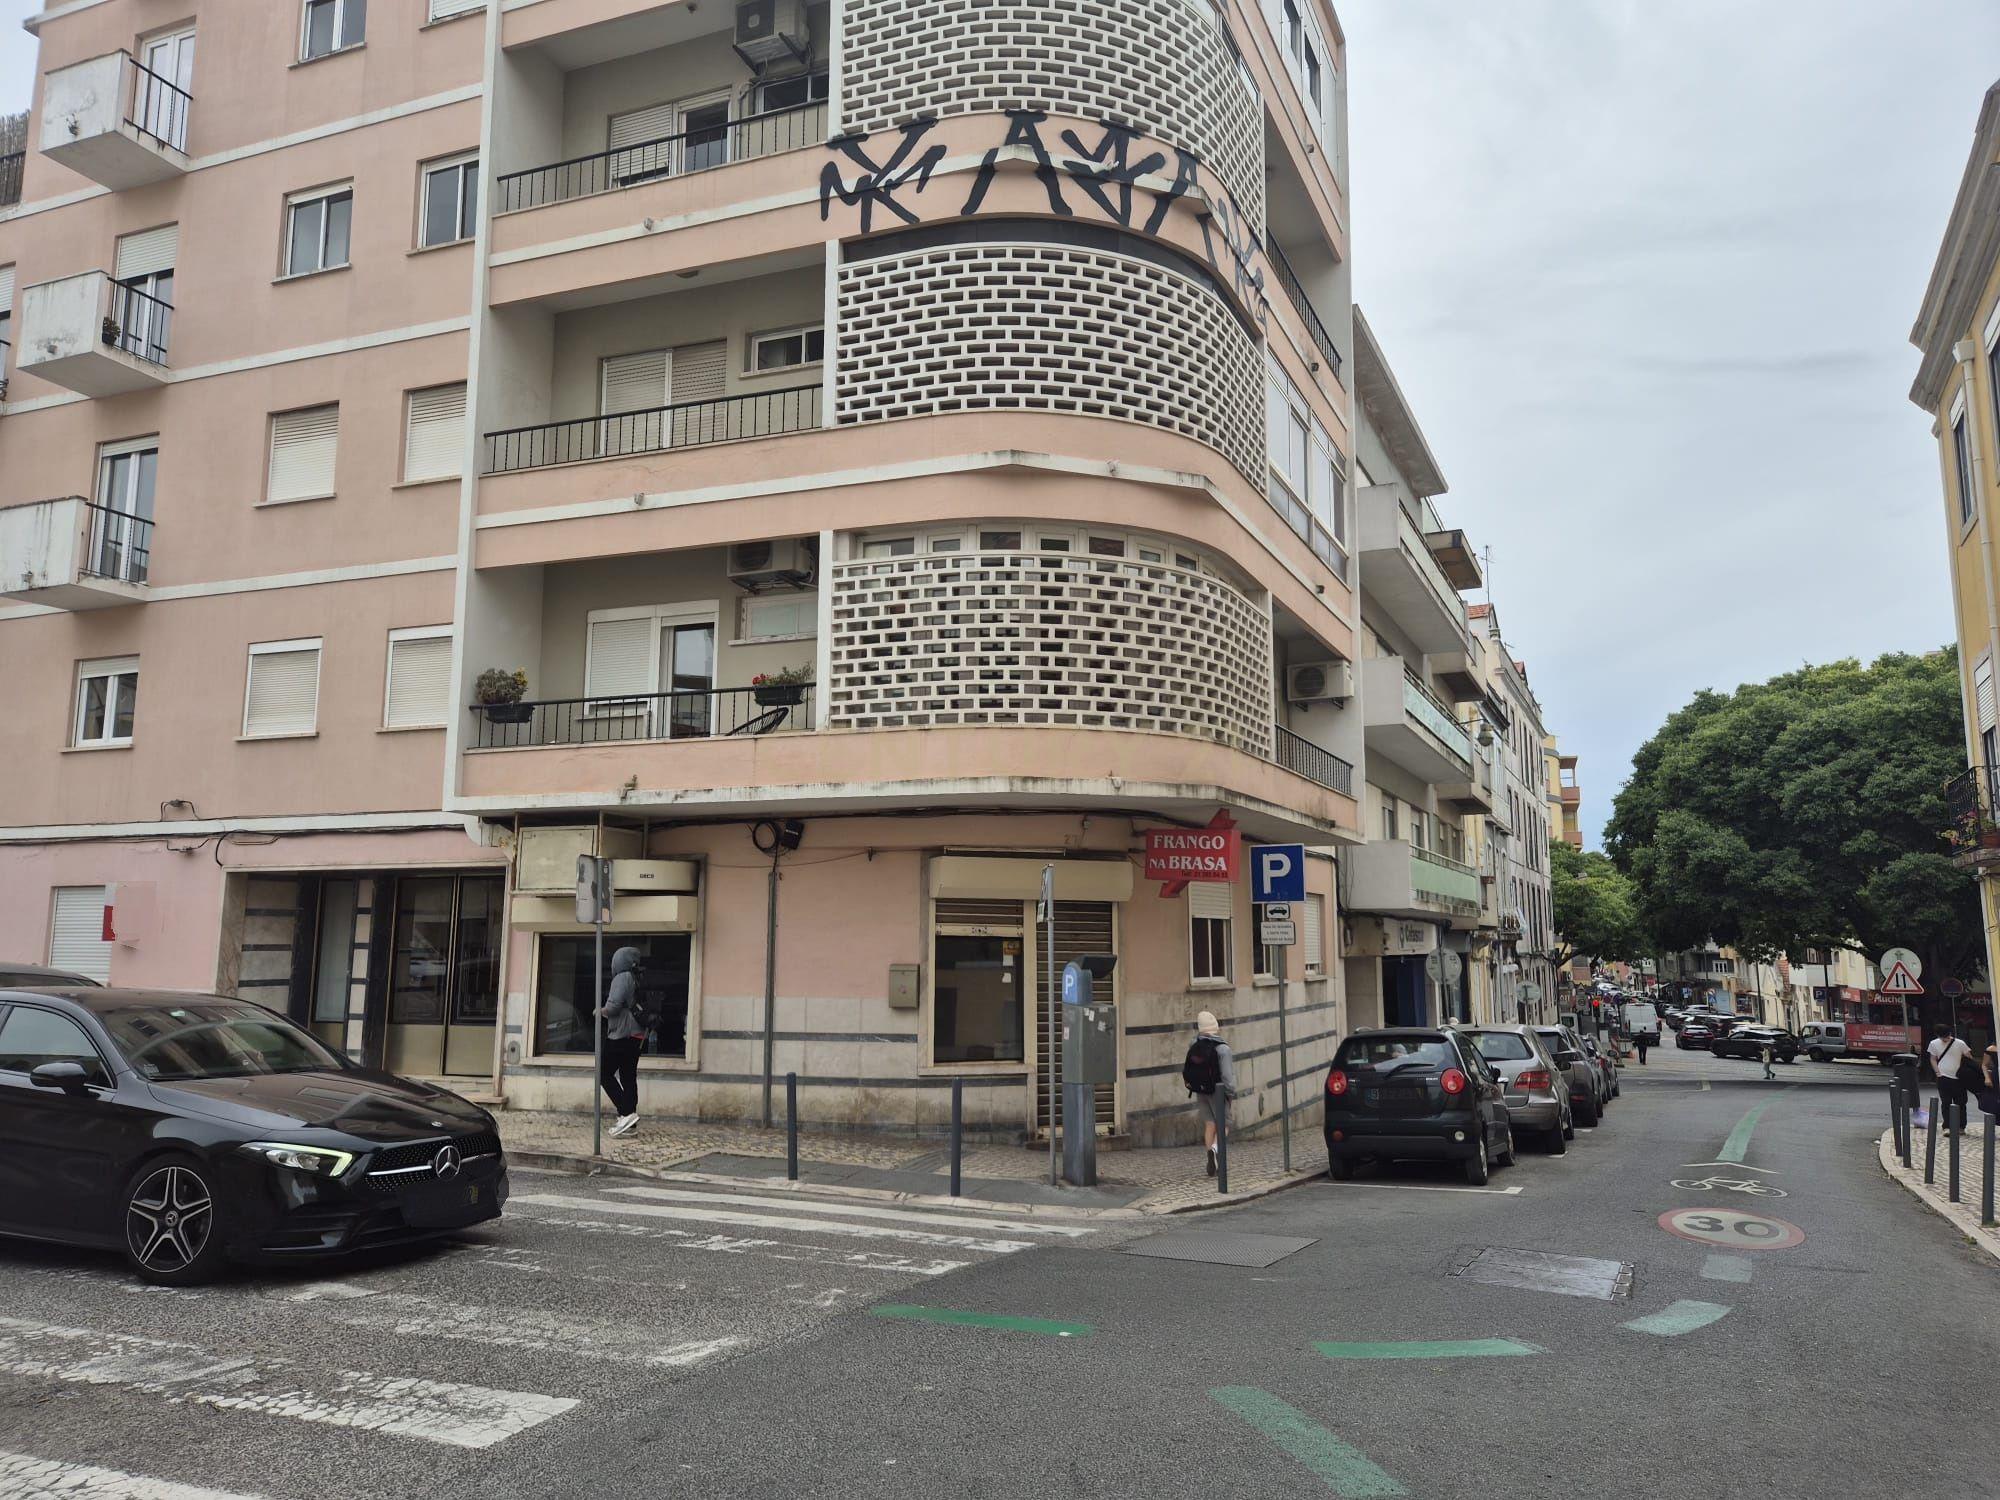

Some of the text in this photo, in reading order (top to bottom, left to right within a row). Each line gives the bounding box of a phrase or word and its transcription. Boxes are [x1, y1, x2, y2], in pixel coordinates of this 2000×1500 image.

[1153, 834, 1225, 850] FRANGO
[1149, 855, 1228, 871] NA BRASA
[1262, 853, 1291, 894] P
[1065, 974, 1074, 995] P
[1815, 990, 1823, 999] P
[1684, 1215, 1780, 1239] 30
